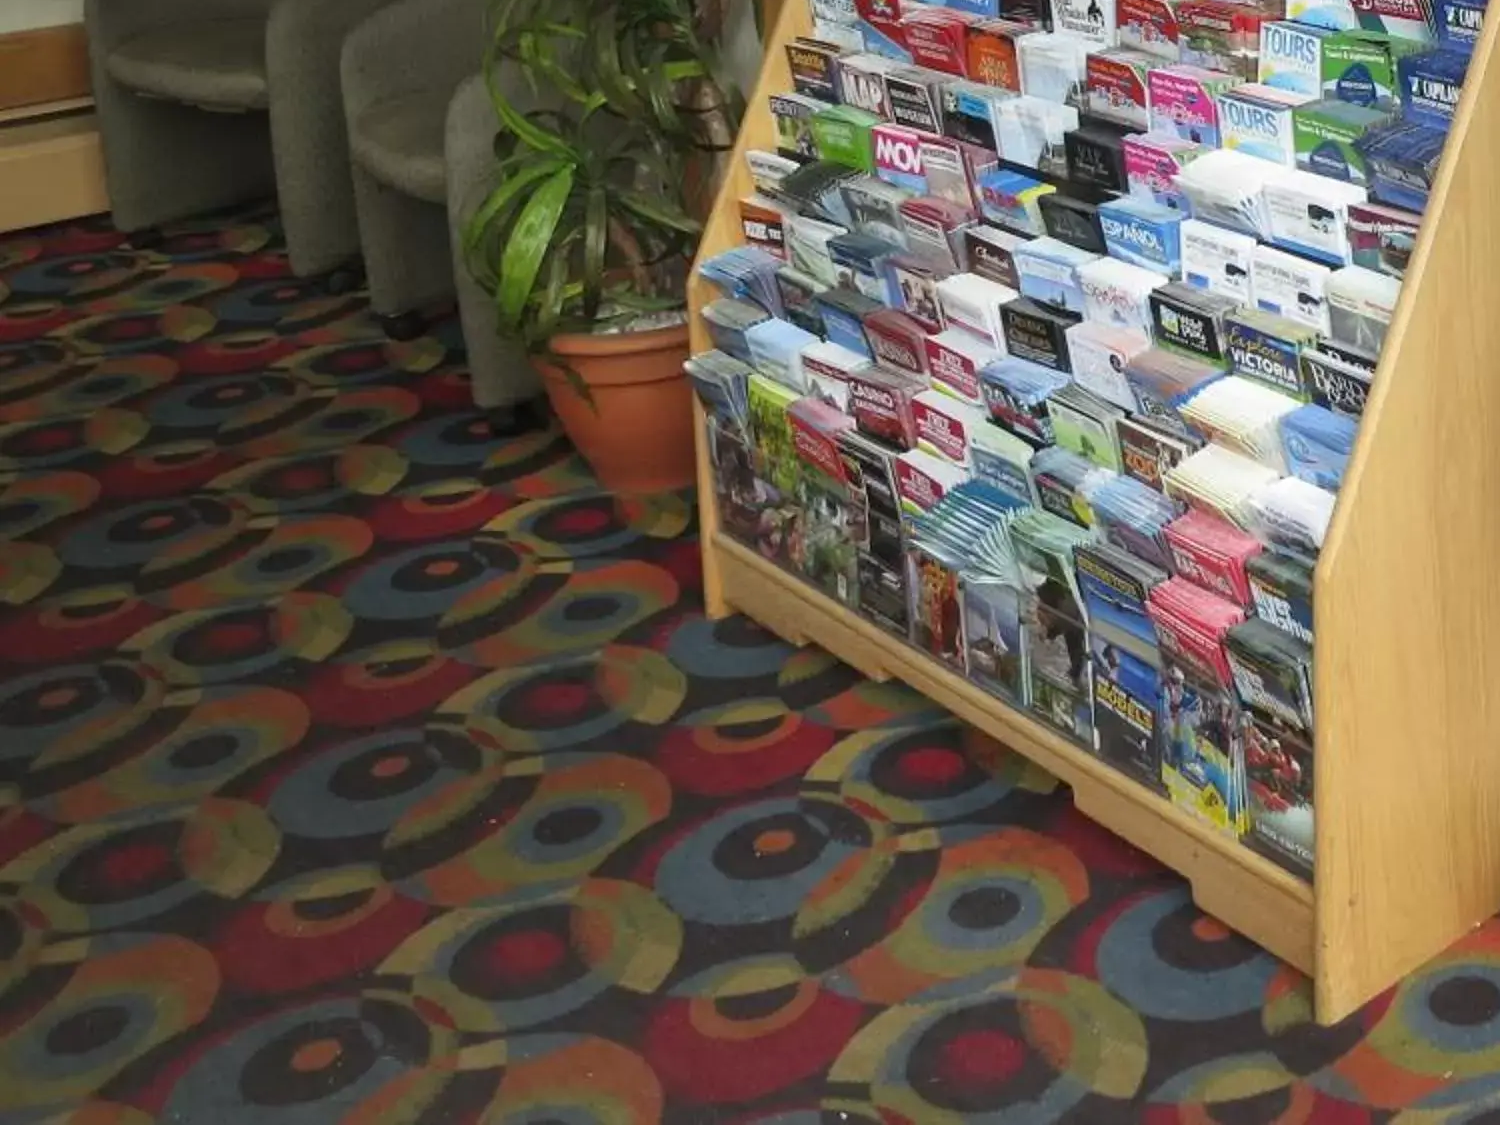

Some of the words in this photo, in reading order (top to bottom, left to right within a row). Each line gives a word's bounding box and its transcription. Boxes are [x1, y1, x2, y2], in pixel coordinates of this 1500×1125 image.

[1264, 27, 1316, 63] TOURS
[1218, 98, 1279, 137] TOURS
[876, 135, 921, 174] MOV
[1102, 216, 1163, 252] ESPAÑOL
[1231, 346, 1297, 384] VICTORIA
[1126, 451, 1157, 479] ZOO
[1096, 682, 1152, 728] MODELS
